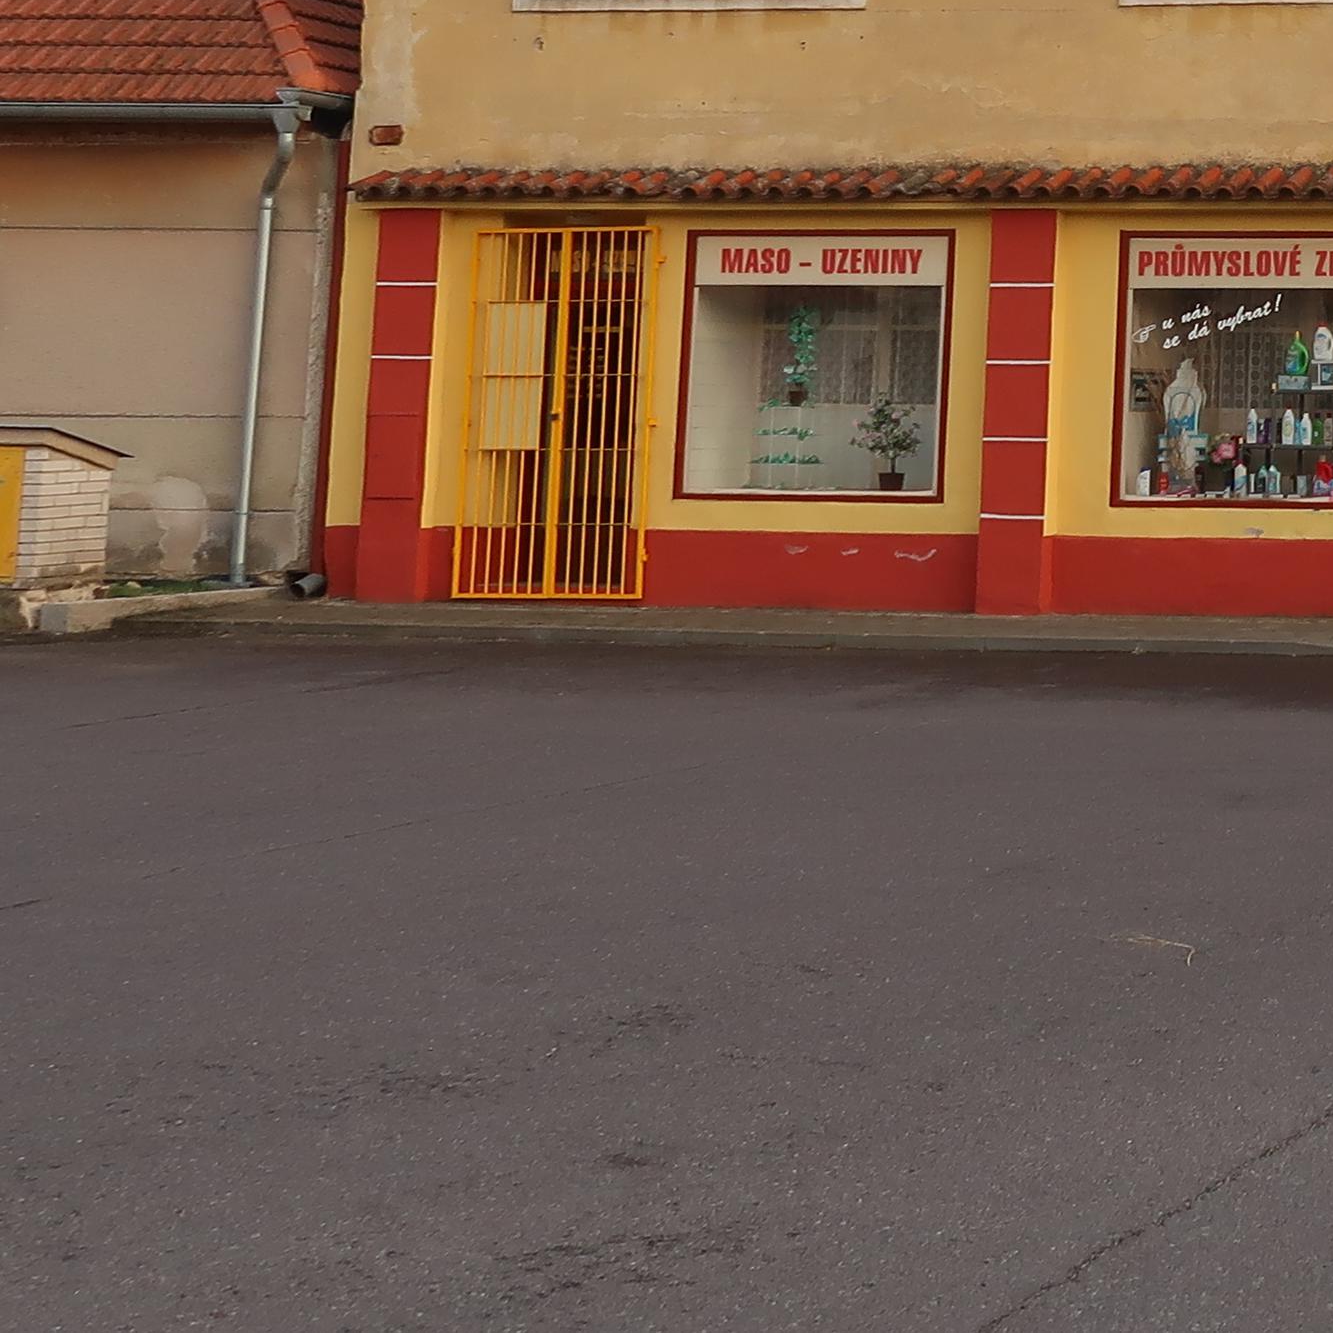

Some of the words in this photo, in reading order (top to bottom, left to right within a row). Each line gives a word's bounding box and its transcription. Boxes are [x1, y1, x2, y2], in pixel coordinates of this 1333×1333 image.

[720, 248, 791, 274] MASO
[821, 248, 923, 275] UZENINY
[1137, 244, 1302, 277] PRŮMYSLOVÉ
[1162, 317, 1175, 330] u
[1181, 303, 1212, 324] nás
[1162, 334, 1181, 349] se
[1188, 320, 1211, 341] dá
